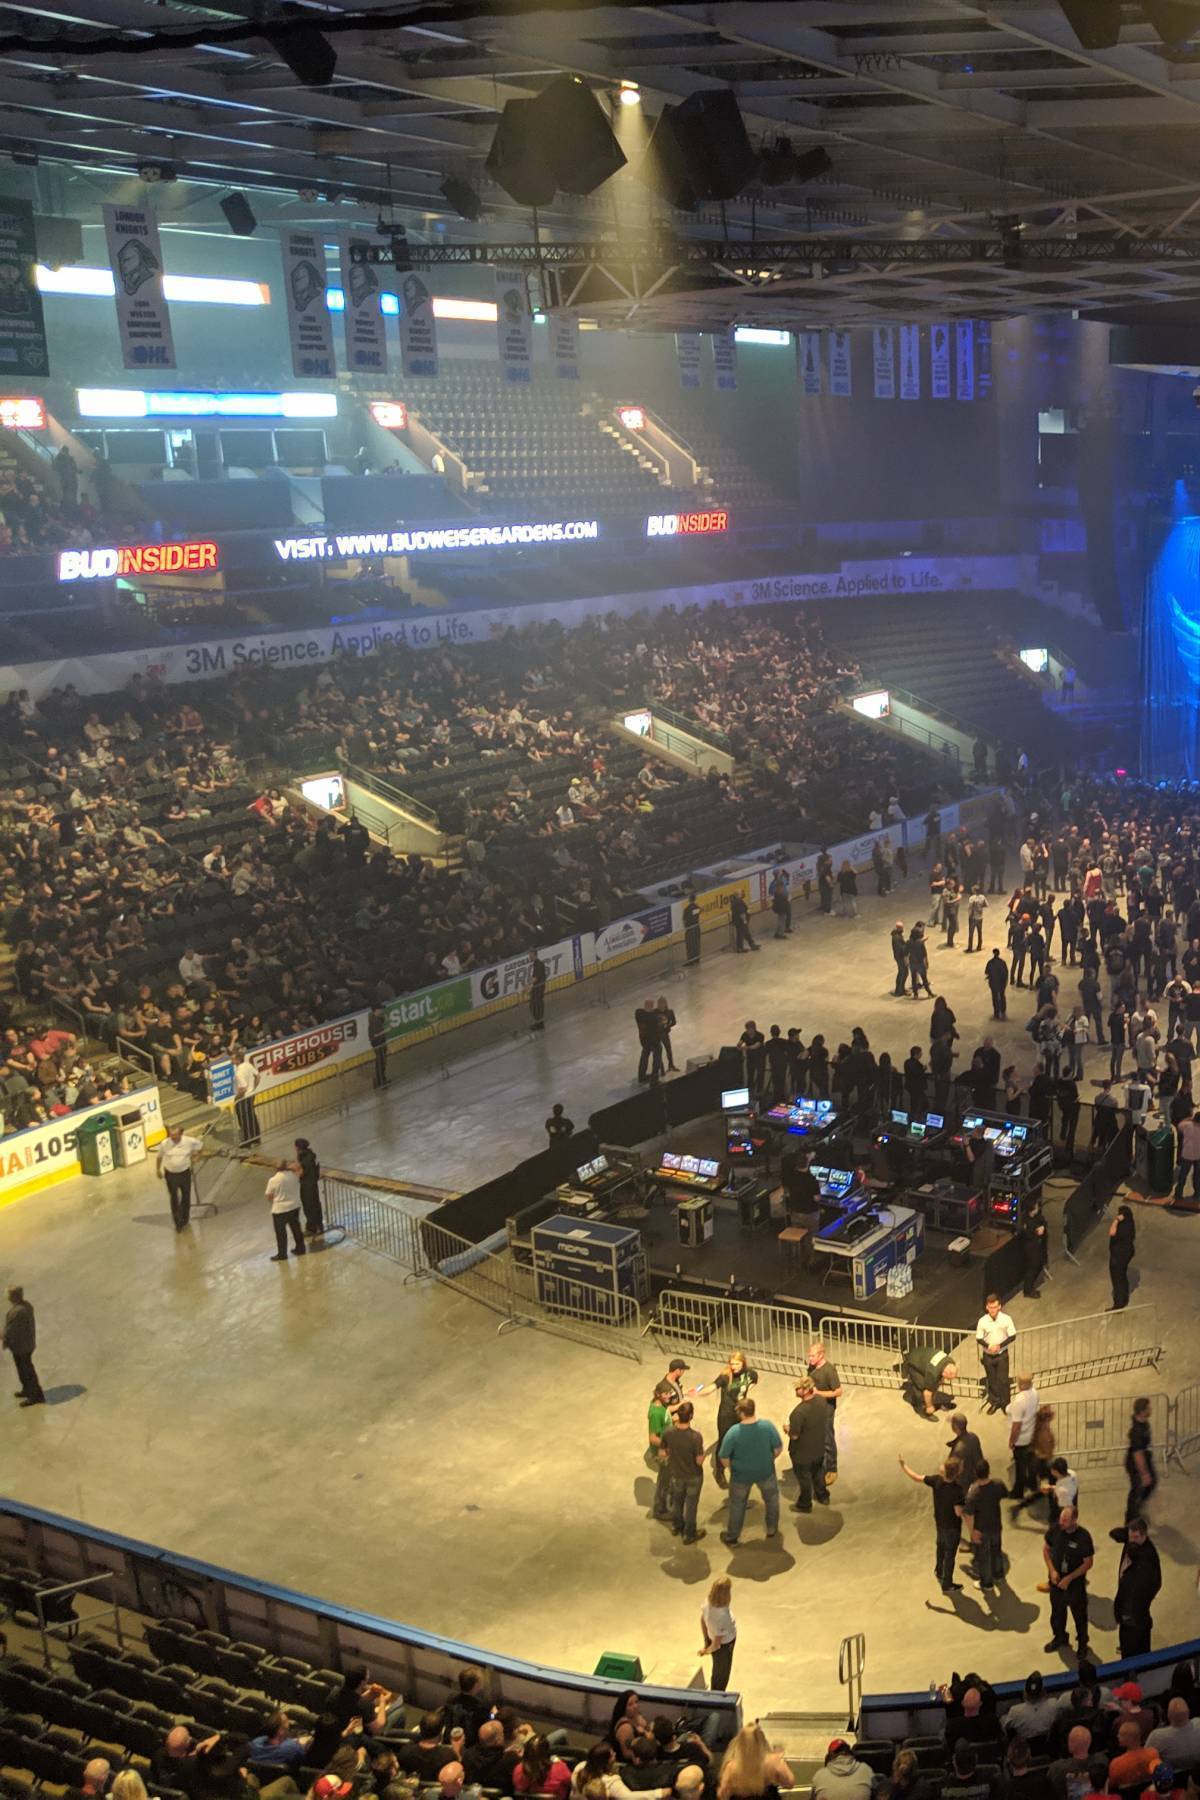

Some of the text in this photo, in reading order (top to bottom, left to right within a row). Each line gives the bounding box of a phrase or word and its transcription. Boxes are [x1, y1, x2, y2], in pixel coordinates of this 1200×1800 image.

[274, 521, 598, 559] VISIT: WWW.BUDWEISERGARDENS.COM
[647, 512, 727, 536] BUDINSIDER
[60, 543, 218, 580] BUDINSIDER
[751, 571, 943, 600] 3M Science. Applied to Life.
[186, 618, 474, 674] 3M Science. Applied to Life.
[253, 1022, 355, 1069] FIREHOUSE
[287, 1047, 325, 1070] SUBS
